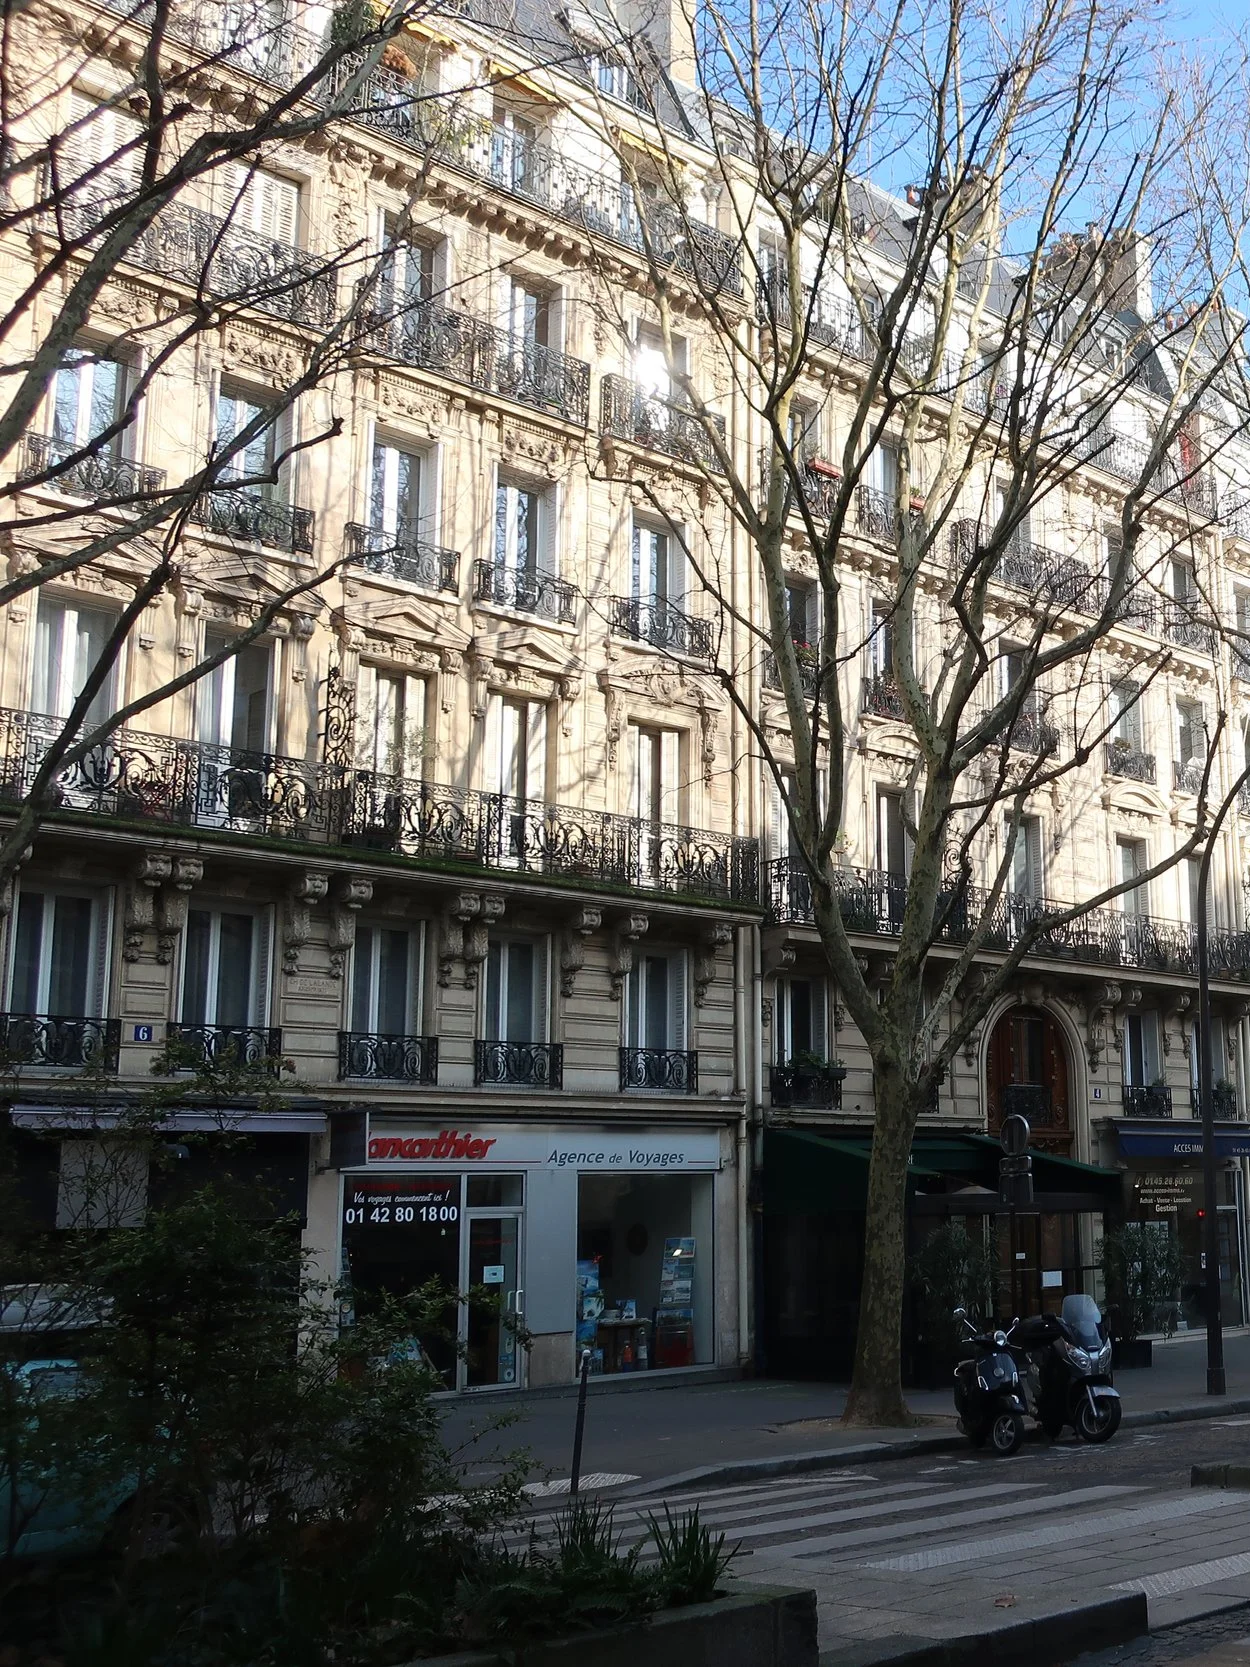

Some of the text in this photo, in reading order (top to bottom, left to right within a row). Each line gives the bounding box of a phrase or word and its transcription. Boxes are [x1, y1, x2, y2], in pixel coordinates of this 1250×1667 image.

[139, 1026, 148, 1040] 6
[369, 1130, 496, 1159] ancarthier
[1173, 1143, 1191, 1153] ACCES
[547, 1149, 685, 1167] Agence de Voyages
[353, 1191, 365, 1204] Vos
[368, 1194, 392, 1206] voyages
[345, 1208, 364, 1224] 01
[369, 1207, 390, 1223] 42
[394, 1206, 415, 1223] 80
[1155, 1203, 1178, 1212] Gestion
